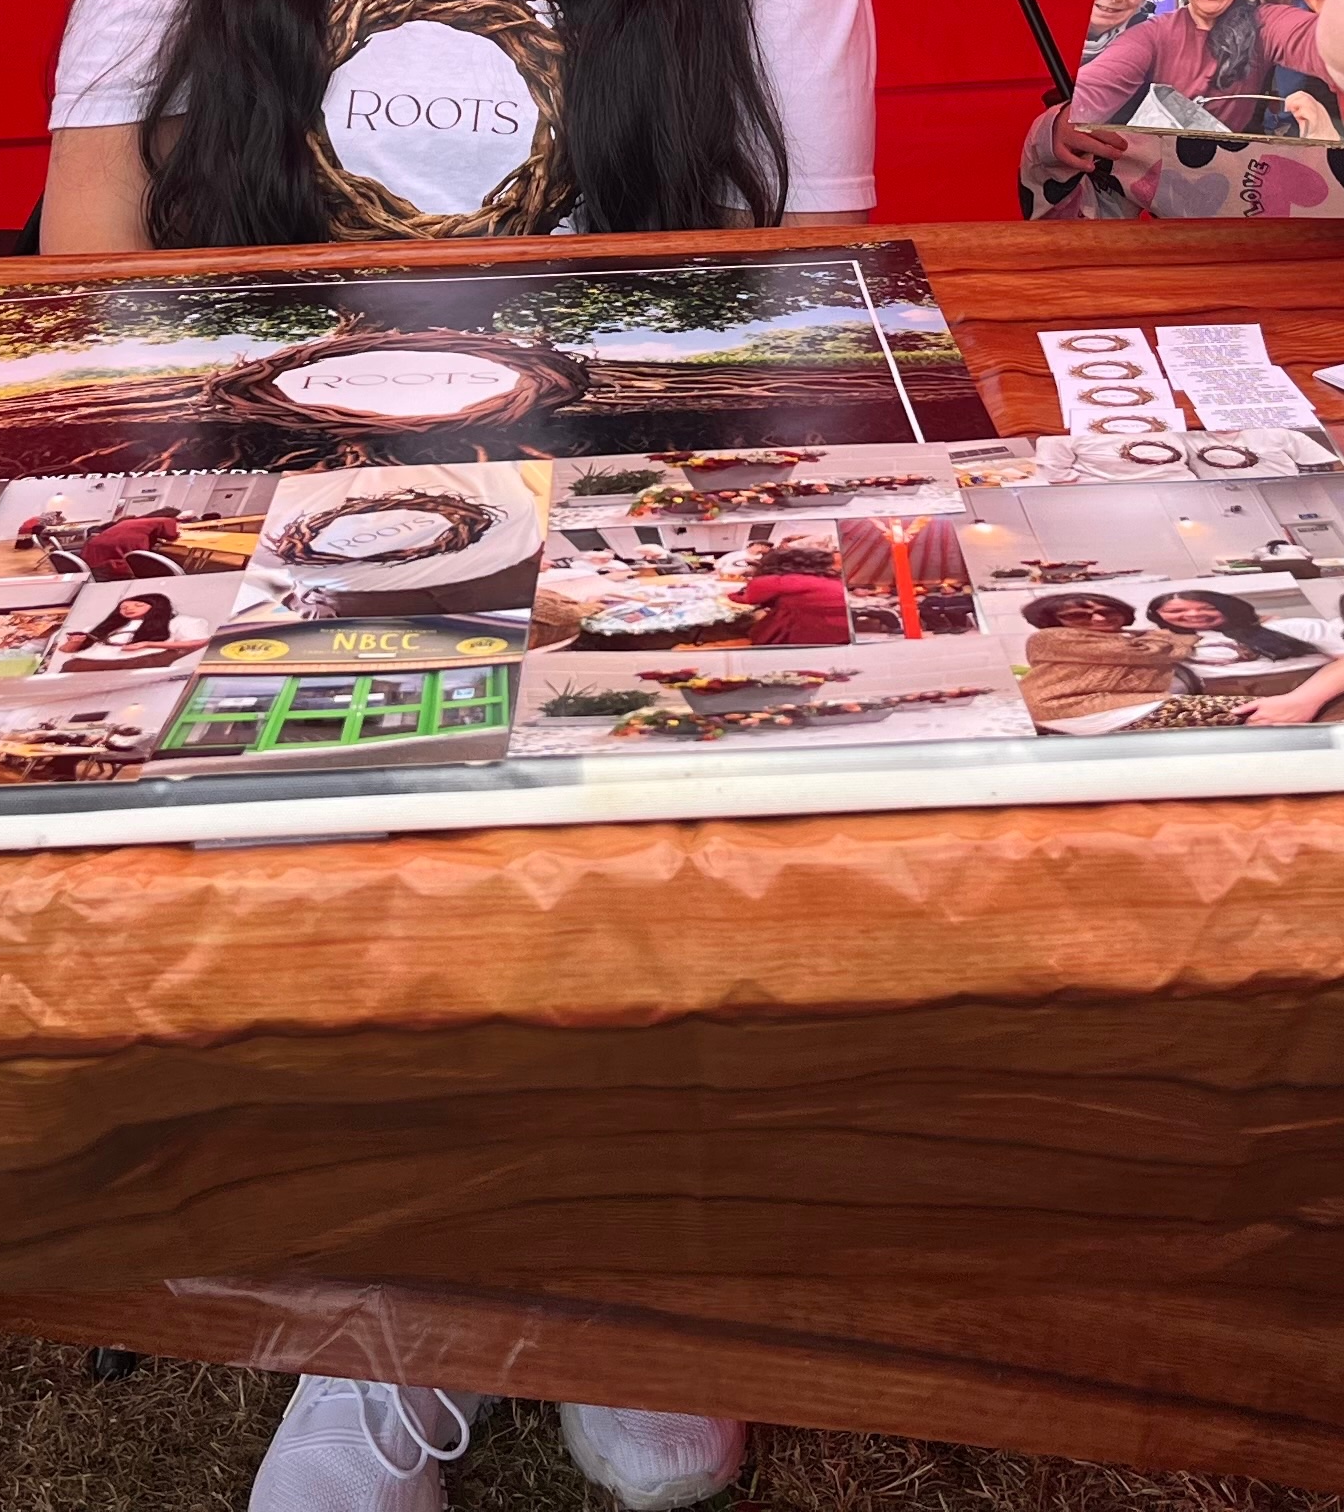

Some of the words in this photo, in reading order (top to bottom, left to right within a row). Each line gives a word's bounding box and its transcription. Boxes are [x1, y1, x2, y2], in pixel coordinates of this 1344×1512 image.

[346, 89, 519, 135] ROOTS
[1240, 158, 1270, 218] LOVE
[301, 370, 501, 391] ROOTS
[327, 515, 436, 551] ROOTS
[333, 633, 420, 650] NBCC
